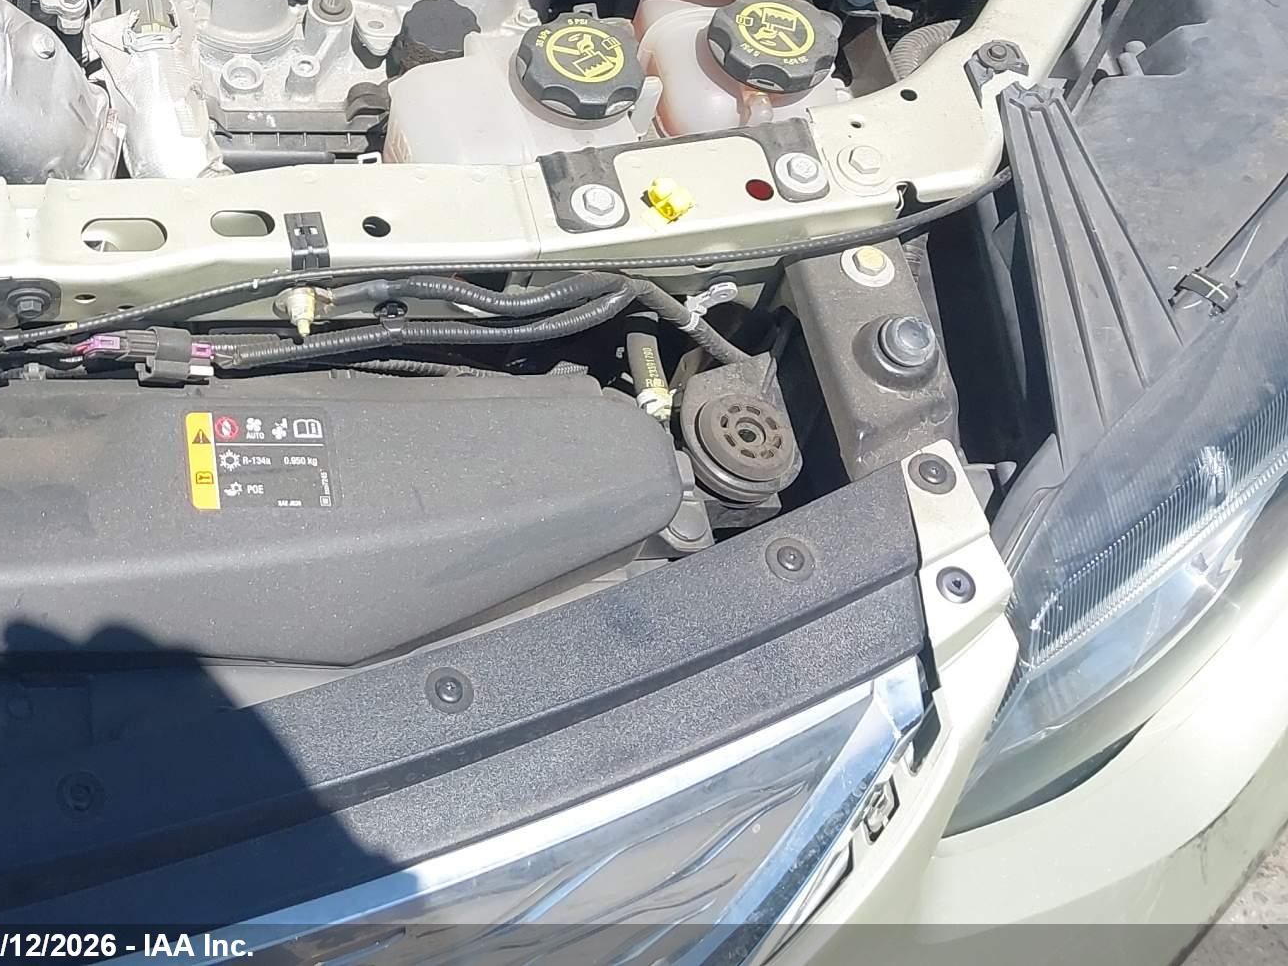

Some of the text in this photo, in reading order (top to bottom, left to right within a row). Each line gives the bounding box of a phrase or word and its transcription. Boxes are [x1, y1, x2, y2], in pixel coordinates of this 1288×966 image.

[242, 456, 272, 465] R-134a
[306, 456, 318, 466] kg
[247, 484, 264, 494] POE
